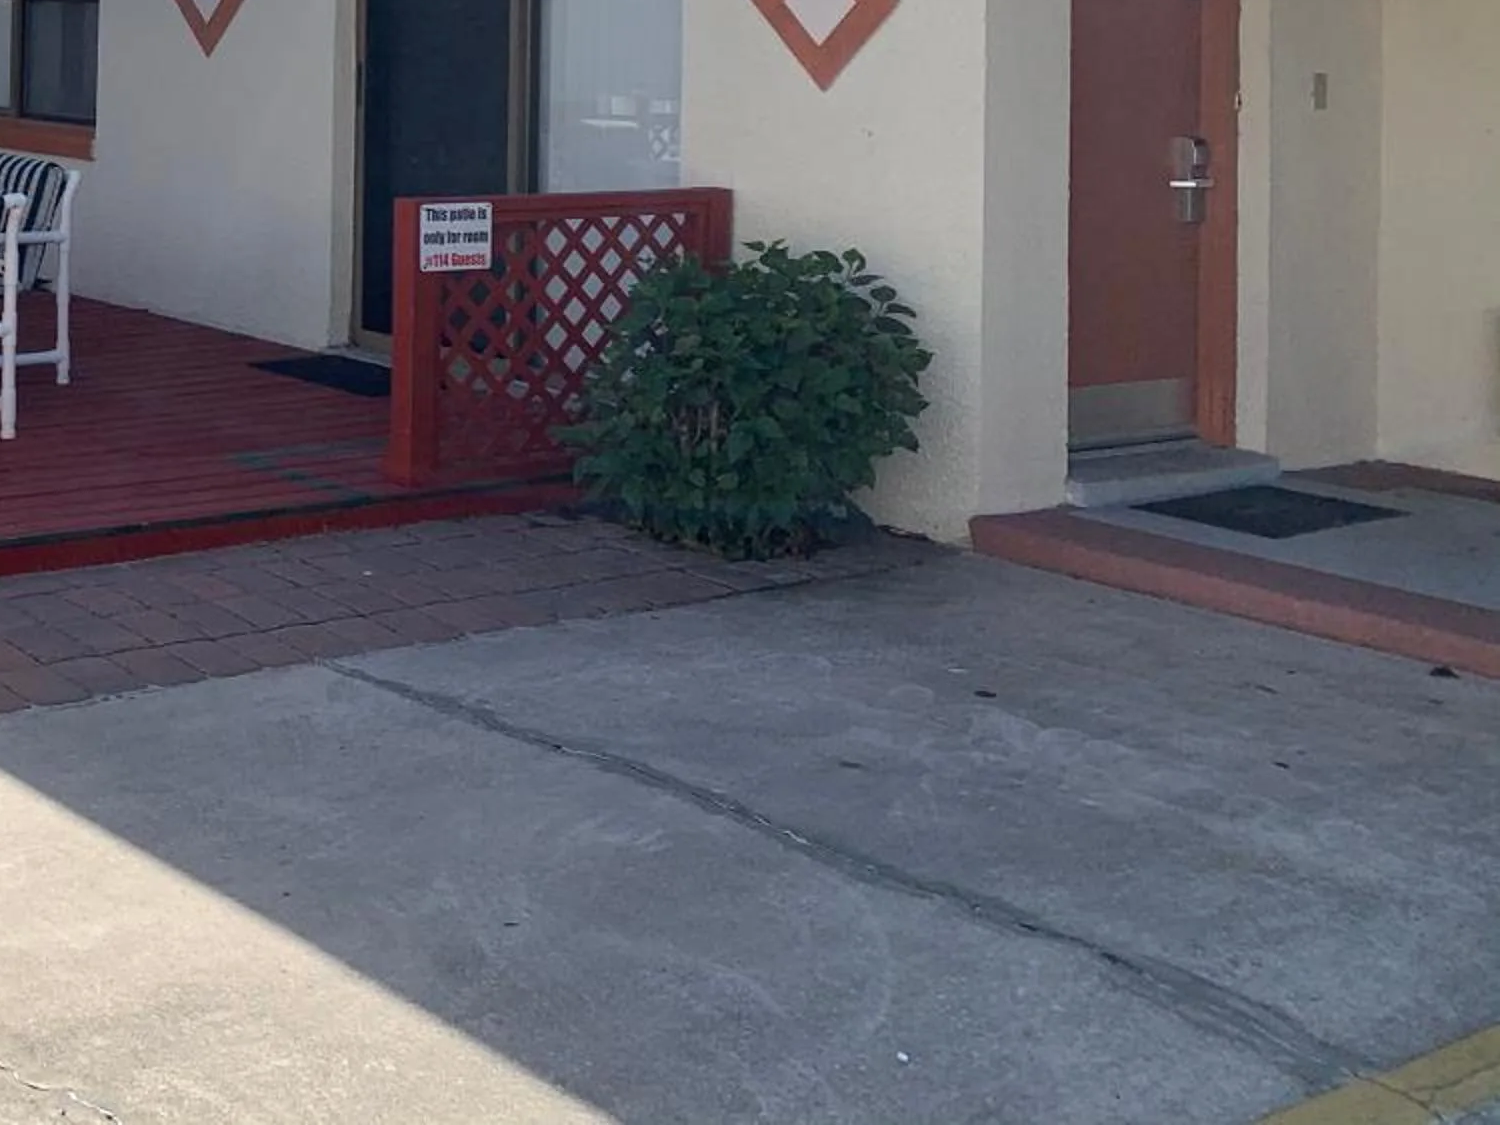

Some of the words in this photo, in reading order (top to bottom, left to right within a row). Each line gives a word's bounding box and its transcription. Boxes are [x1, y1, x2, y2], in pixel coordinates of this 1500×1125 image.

[425, 208, 447, 222] This
[450, 208, 476, 223] patio
[478, 207, 487, 220] is
[424, 231, 445, 245] only
[447, 230, 461, 244] for
[463, 231, 489, 243] room
[452, 253, 485, 266] Guests
